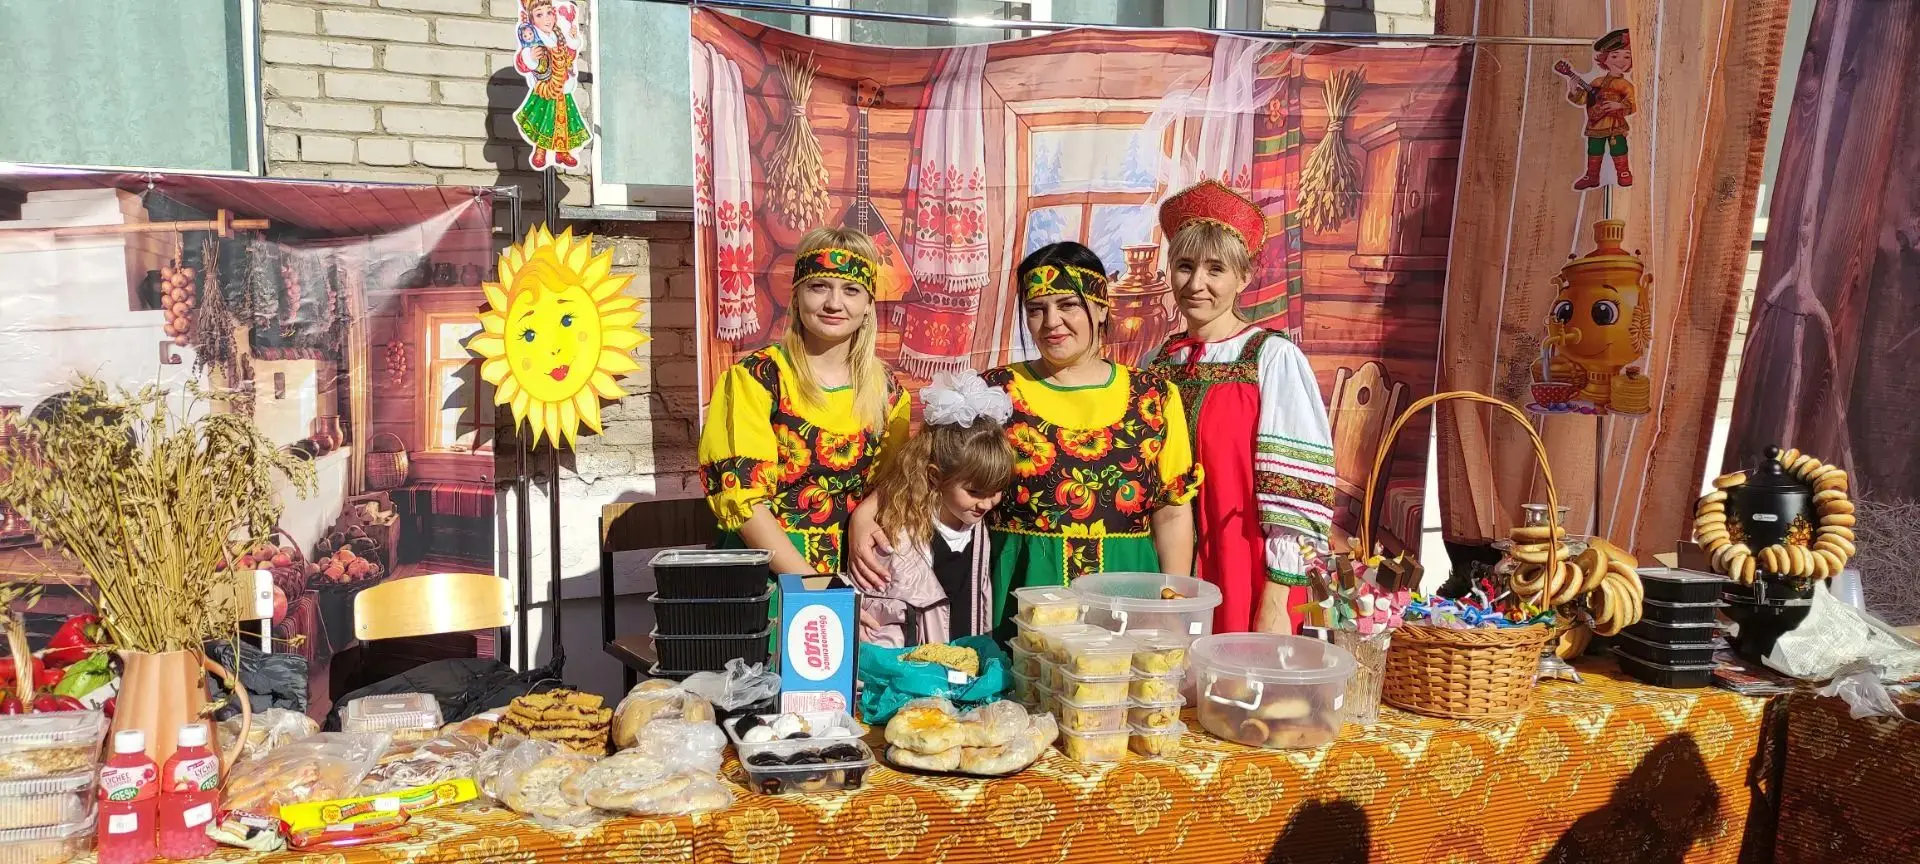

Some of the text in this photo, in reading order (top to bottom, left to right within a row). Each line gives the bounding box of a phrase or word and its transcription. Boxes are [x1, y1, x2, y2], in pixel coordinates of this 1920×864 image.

[804, 620, 822, 668] ЧУДО
[194, 760, 216, 777] LYCHEE
[104, 772, 130, 785] LYCHEE
[111, 788, 137, 801] FRESH
